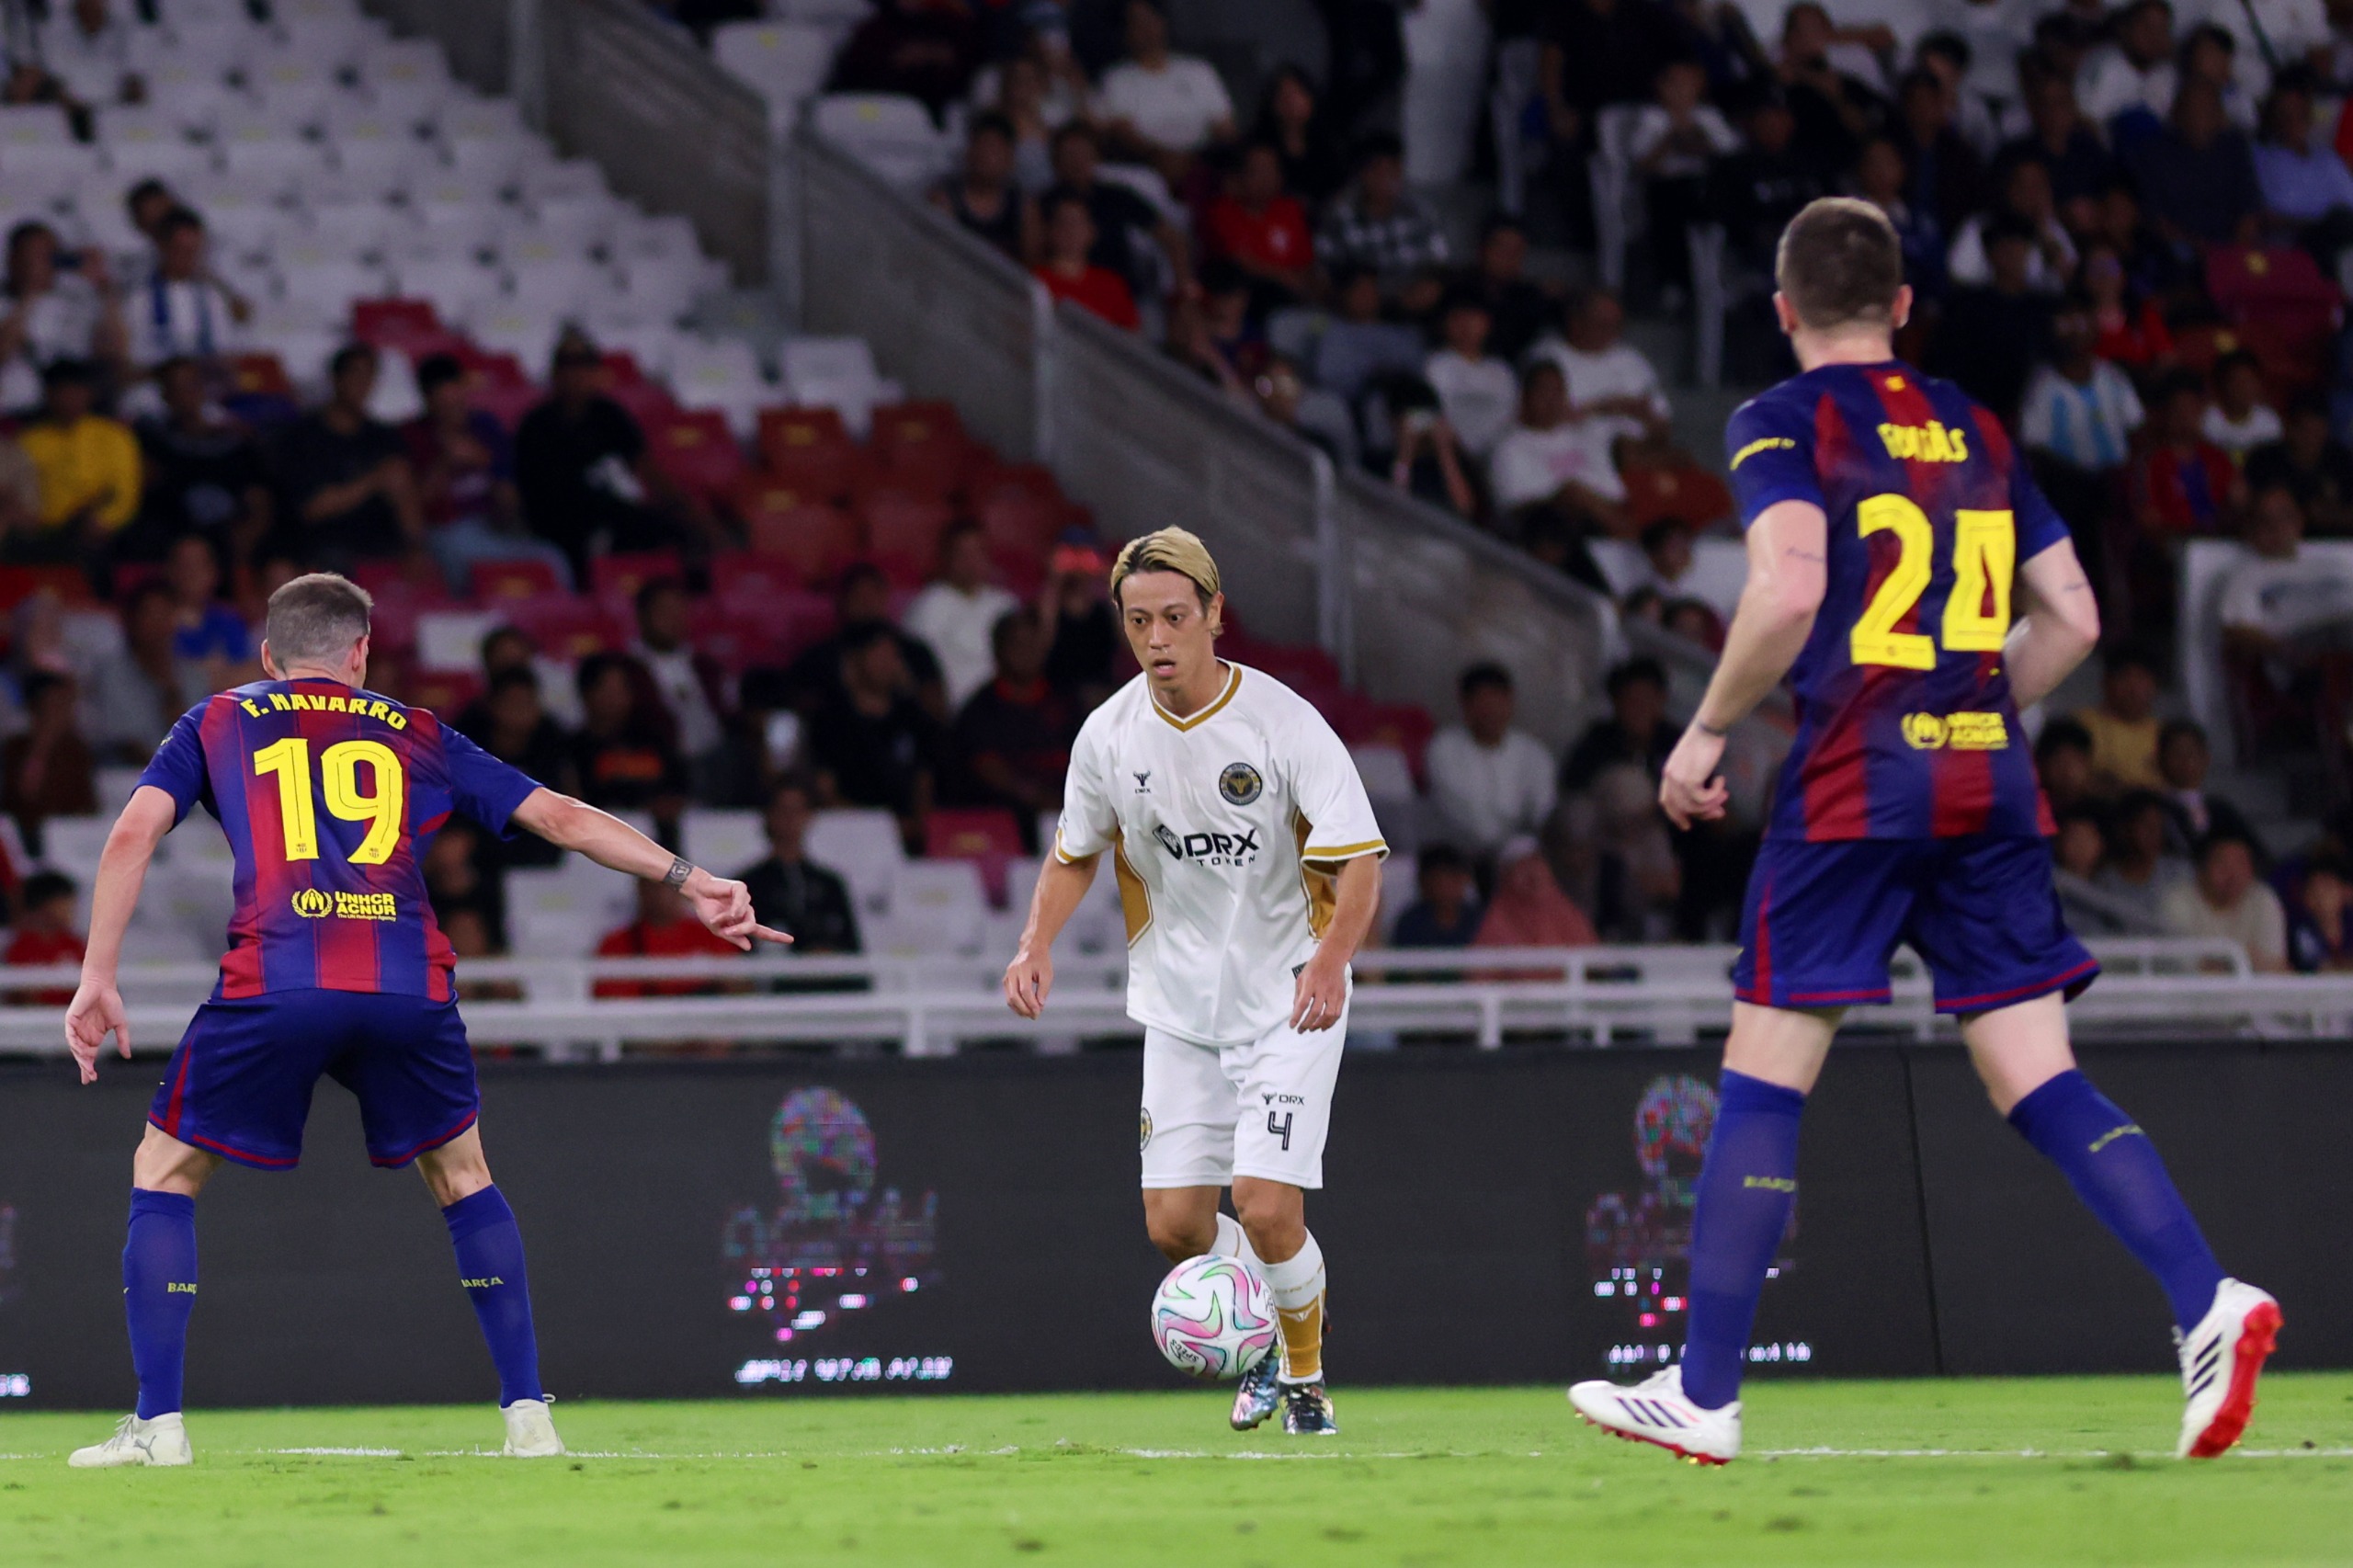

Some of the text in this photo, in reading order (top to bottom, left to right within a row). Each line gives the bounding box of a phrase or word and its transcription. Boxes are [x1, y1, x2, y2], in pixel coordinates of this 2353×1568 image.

[1850, 493, 2016, 671] 24
[240, 693, 407, 731] F. NAVARRO
[253, 738, 403, 865] 19
[1184, 827, 1259, 857] DRX
[1197, 854, 1256, 867] TOKEN
[335, 891, 395, 905] UNHCR
[336, 903, 396, 915] ACNUR
[1279, 1094, 1305, 1106] DRX
[1267, 1110, 1293, 1152] 4
[460, 1277, 504, 1288] ARÇA
